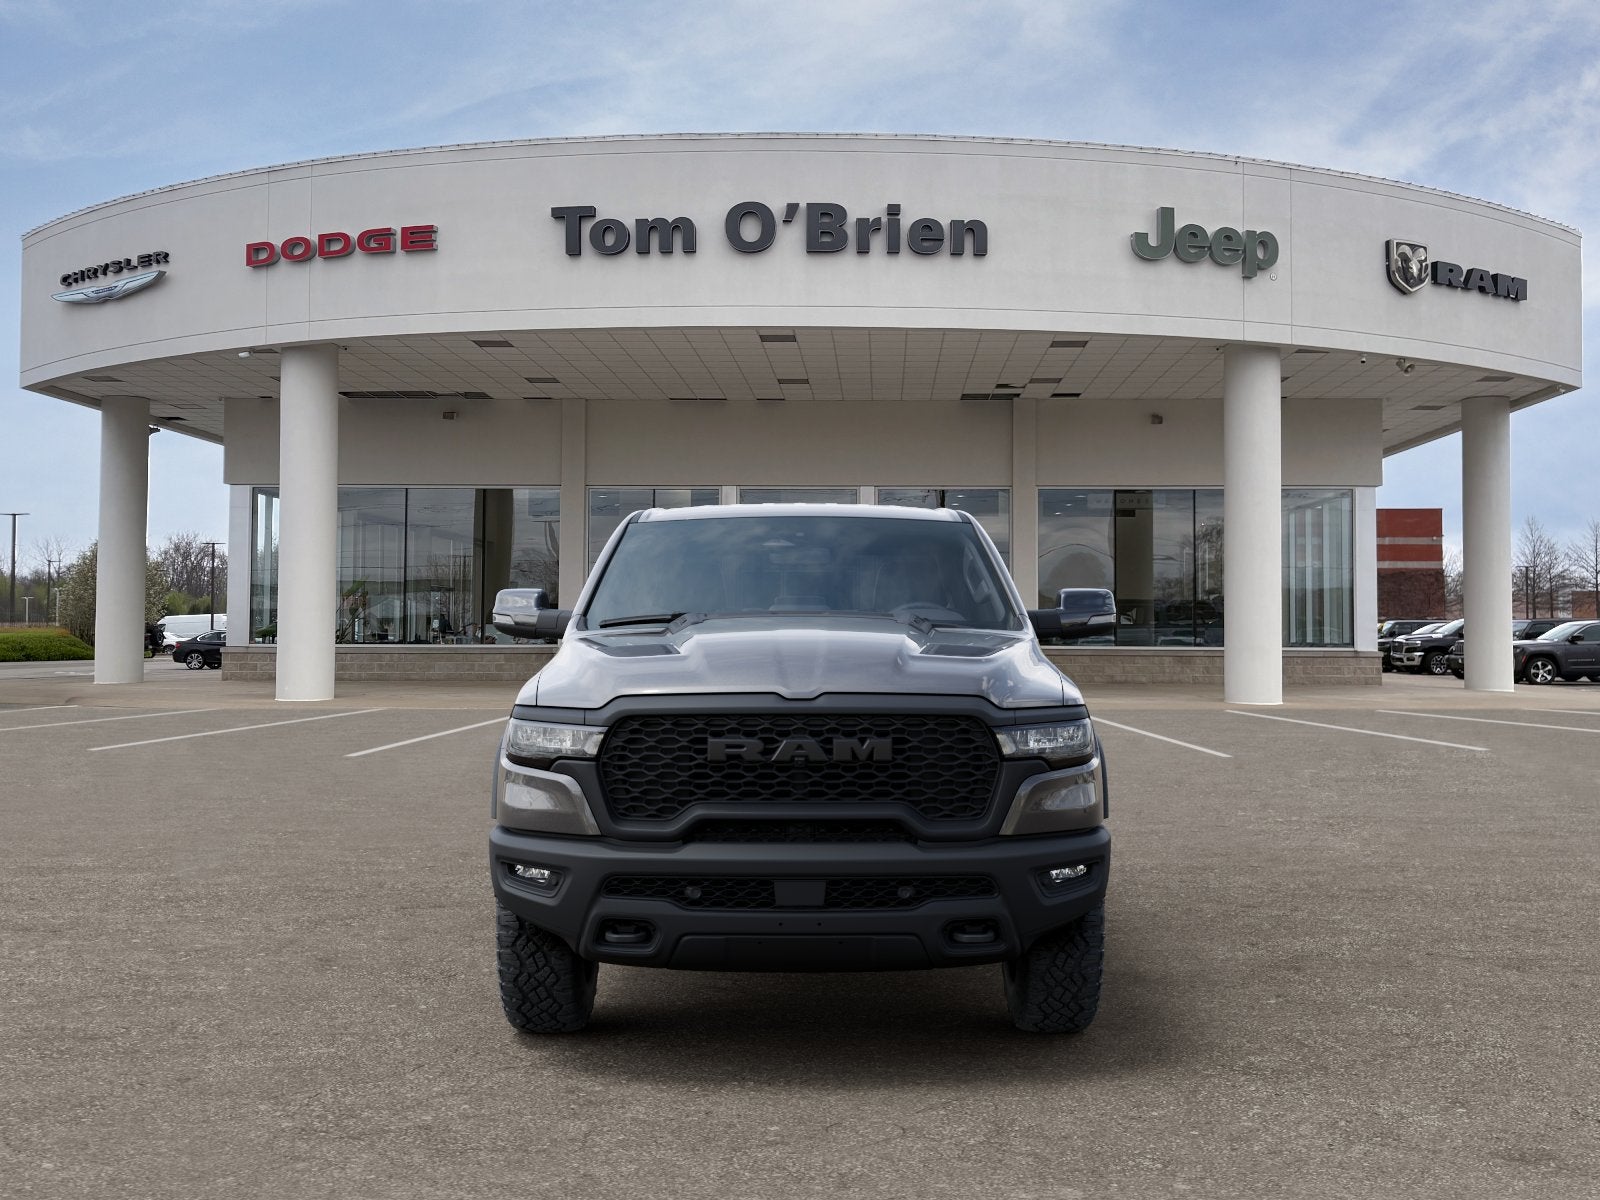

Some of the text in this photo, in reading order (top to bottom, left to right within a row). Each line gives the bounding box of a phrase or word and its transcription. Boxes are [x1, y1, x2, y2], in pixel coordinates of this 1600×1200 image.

[246, 225, 438, 268] DODGE
[551, 201, 988, 256] Tom O'Brien
[1131, 207, 1279, 278] Jeep
[60, 251, 169, 286] CHRYSLER
[1431, 261, 1527, 301] RAM
[707, 737, 892, 761] RAM
